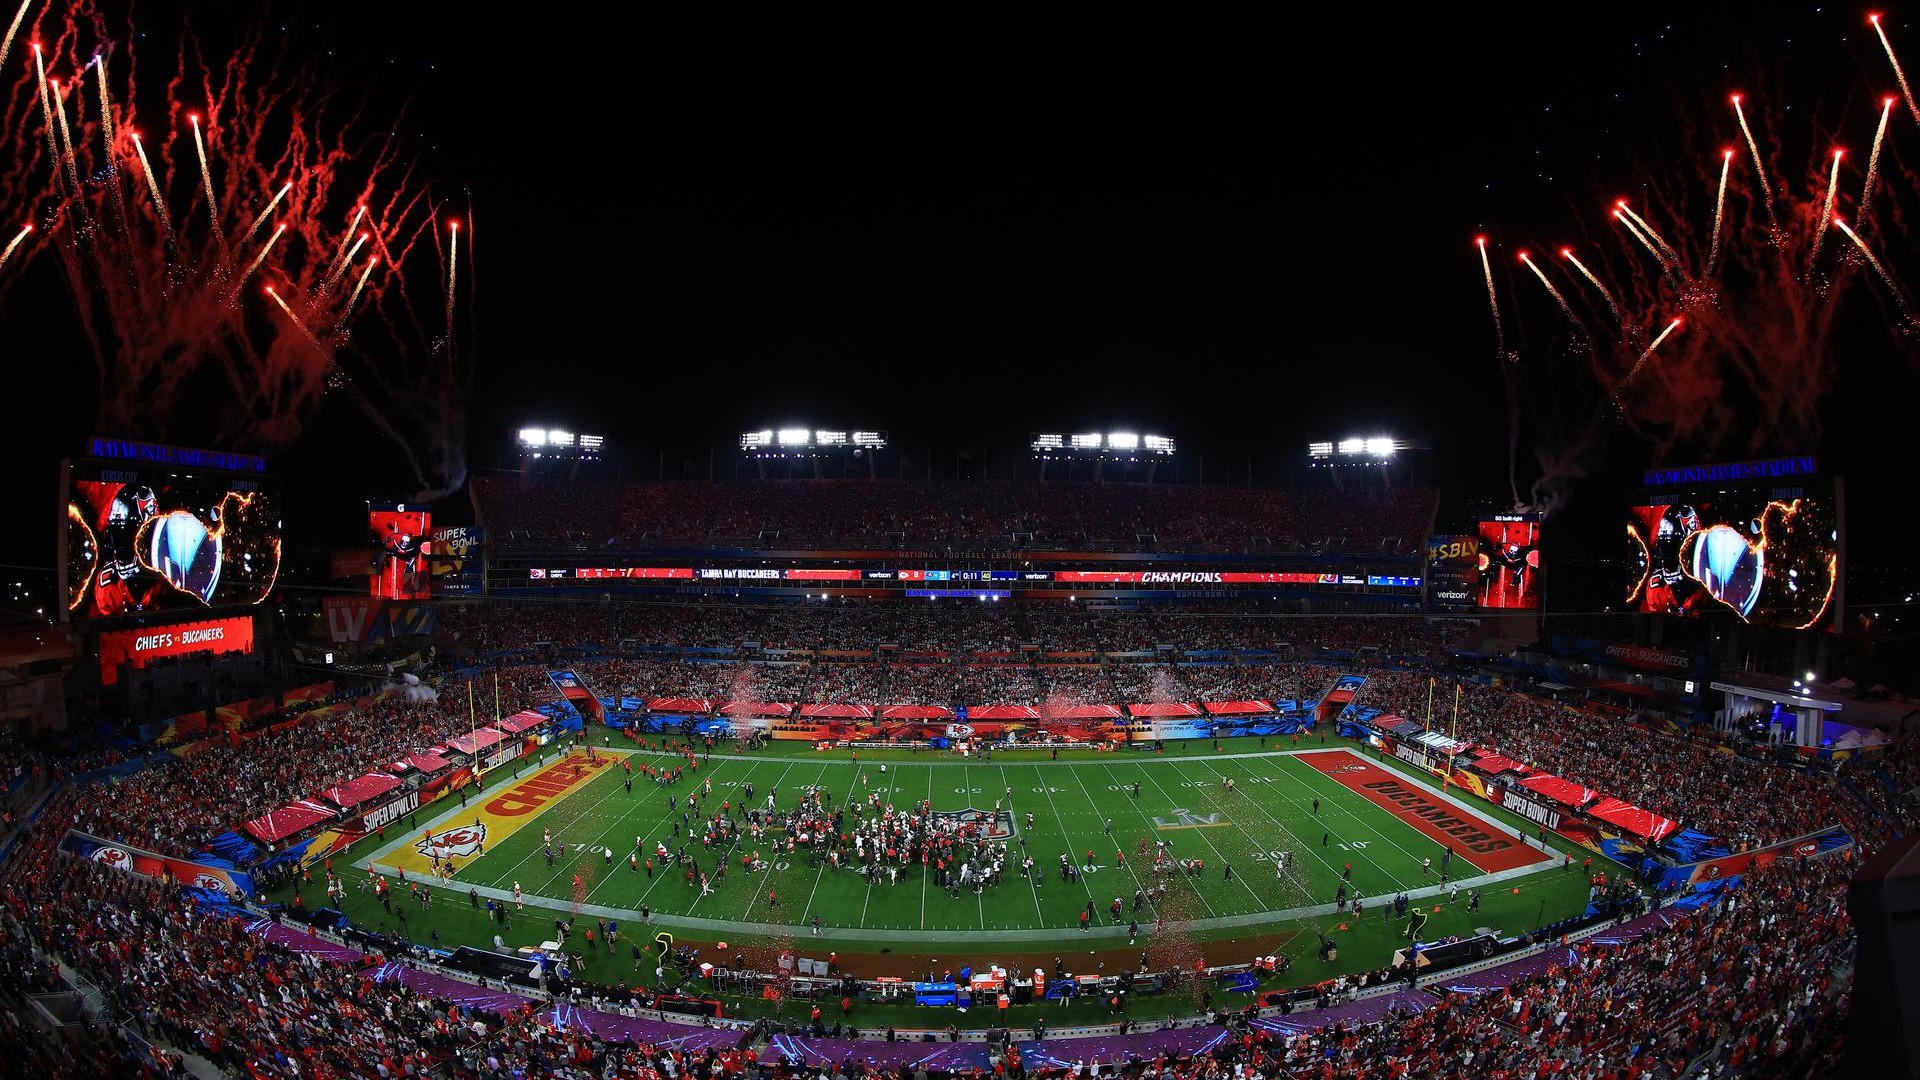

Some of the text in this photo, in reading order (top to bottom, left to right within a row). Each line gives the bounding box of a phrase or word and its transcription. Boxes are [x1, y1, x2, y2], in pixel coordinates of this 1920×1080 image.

[93, 438, 167, 464] RAYMOND
[1644, 465, 1707, 486] RAYMOND
[434, 527, 467, 542] SUPER
[452, 535, 480, 550] BOWL
[900, 551, 1023, 559] NATIONAL FOOTBALL LEAGUE
[1429, 541, 1479, 561] #SBLV
[701, 569, 780, 579] TAMPA BAY BUCCANEERS
[1141, 572, 1222, 582] CHAMPIONS
[1437, 591, 1469, 599] verizon
[327, 607, 369, 643] LV
[135, 633, 173, 651] CHIEFS
[182, 627, 224, 645] BUCCANEERS
[1605, 645, 1689, 668] CHIEFS BUCCANEERS
[1396, 743, 1414, 763] SUPER
[484, 754, 610, 817] CHIEFS
[364, 791, 419, 833] SUPER BOWL LV
[1360, 779, 1514, 857] BUCCANEERS
[1503, 790, 1560, 829] SUPER BOWL LV
